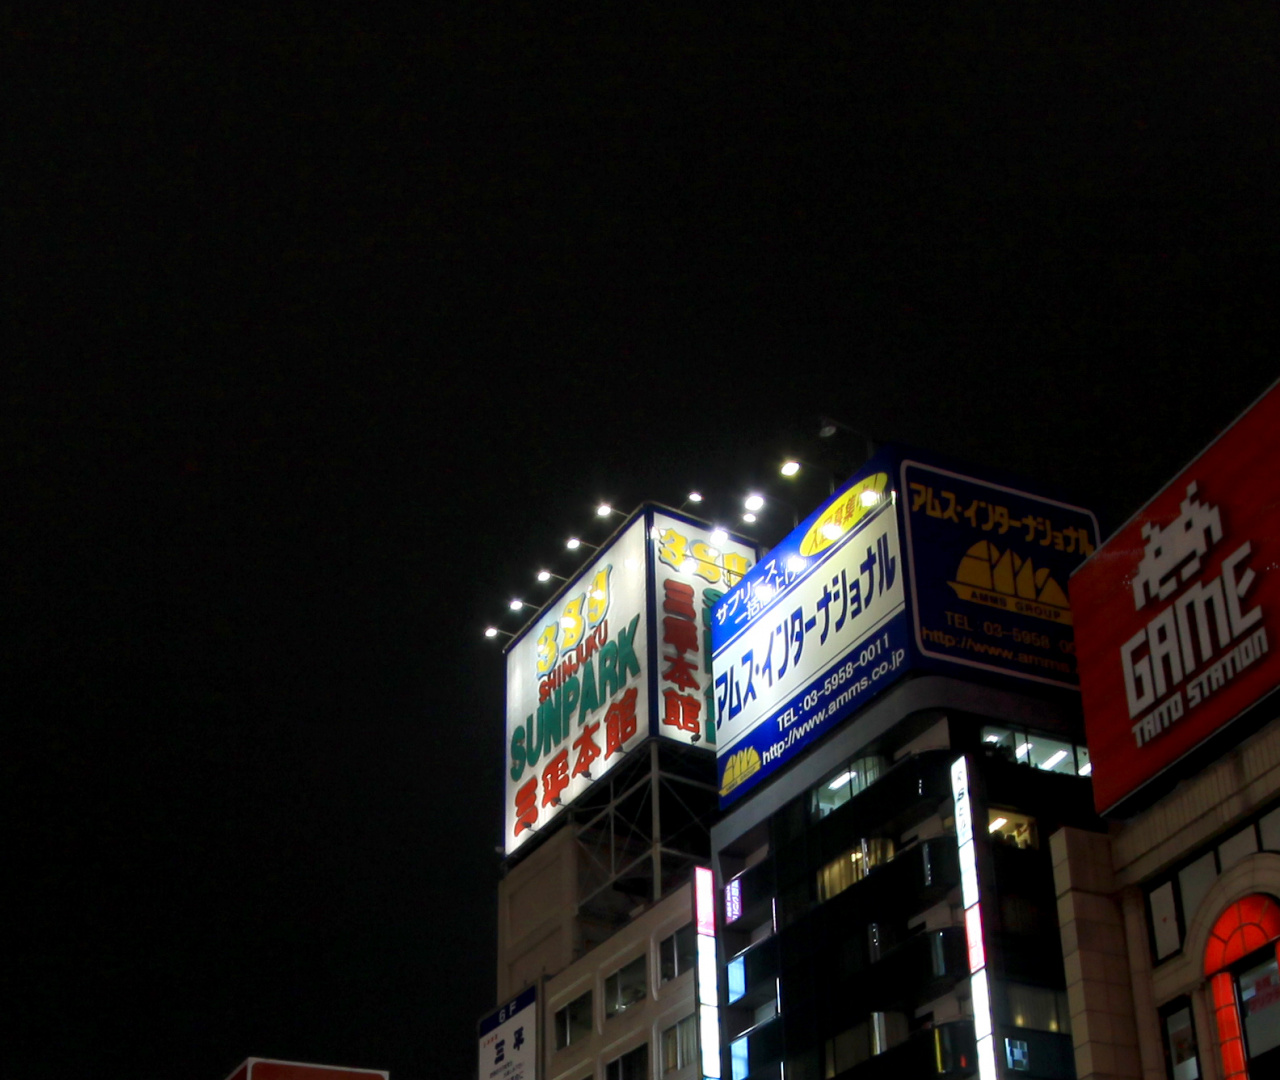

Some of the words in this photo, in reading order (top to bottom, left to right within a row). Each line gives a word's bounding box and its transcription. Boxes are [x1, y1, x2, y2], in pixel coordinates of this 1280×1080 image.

[908, 482, 1095, 557] アムス・インターナショナル
[538, 619, 609, 704] SHINJUKU
[661, 577, 702, 735] 三平本館
[714, 530, 897, 732] アムス・インターナショナル
[969, 589, 1009, 609] AMMS
[1014, 600, 1063, 621] GROUP
[1119, 540, 1265, 720] GAME
[509, 612, 642, 783] SUNPARK
[761, 647, 905, 766] http://www.amms.co.jp
[1130, 697, 1185, 749] TAITO
[1186, 626, 1270, 709] STATION
[513, 686, 639, 838] 三平本館
[493, 1025, 525, 1065] 三平
[498, 1002, 517, 1024] 6F
